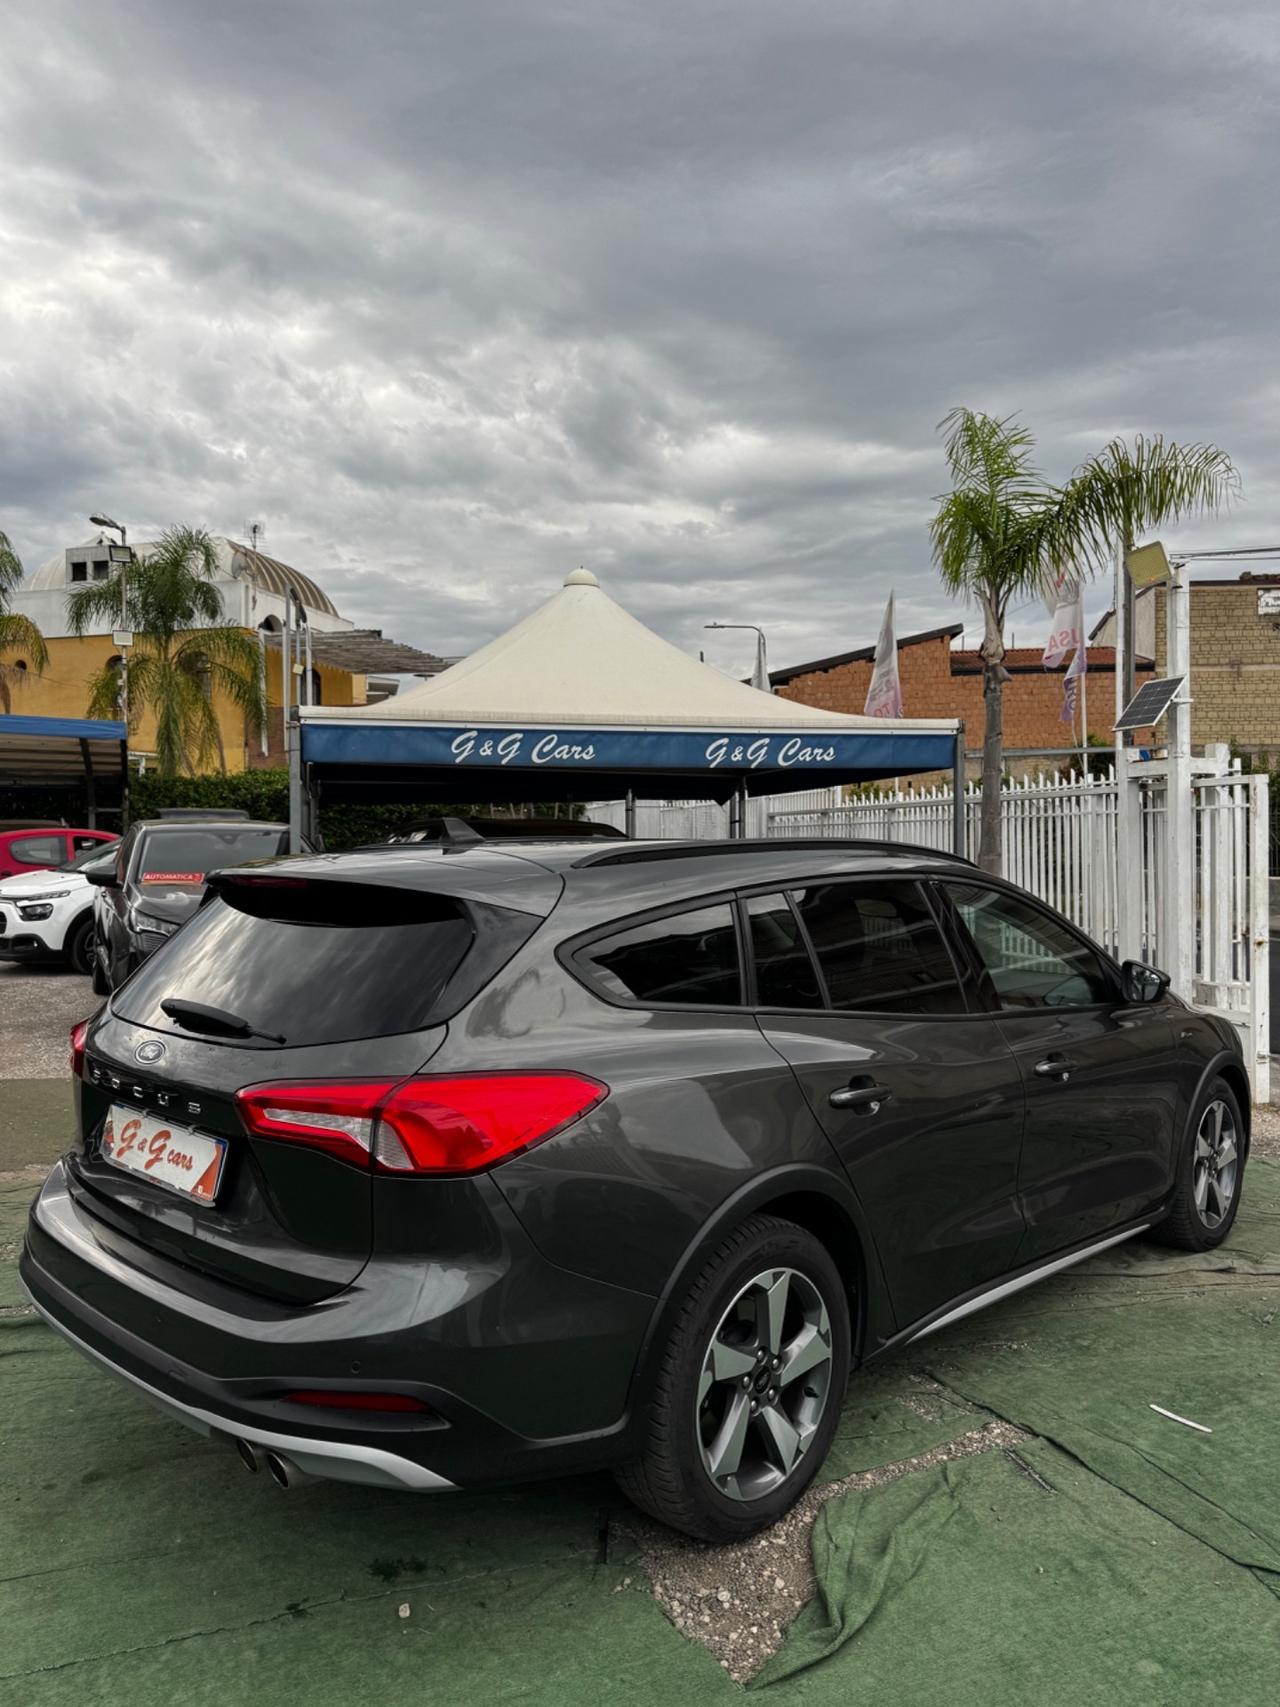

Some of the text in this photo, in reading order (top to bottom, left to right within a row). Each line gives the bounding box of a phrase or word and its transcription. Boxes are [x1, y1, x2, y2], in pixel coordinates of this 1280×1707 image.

[531, 734, 596, 764] Cars
[777, 738, 837, 766] Cars
[167, 1149, 193, 1172] cars
